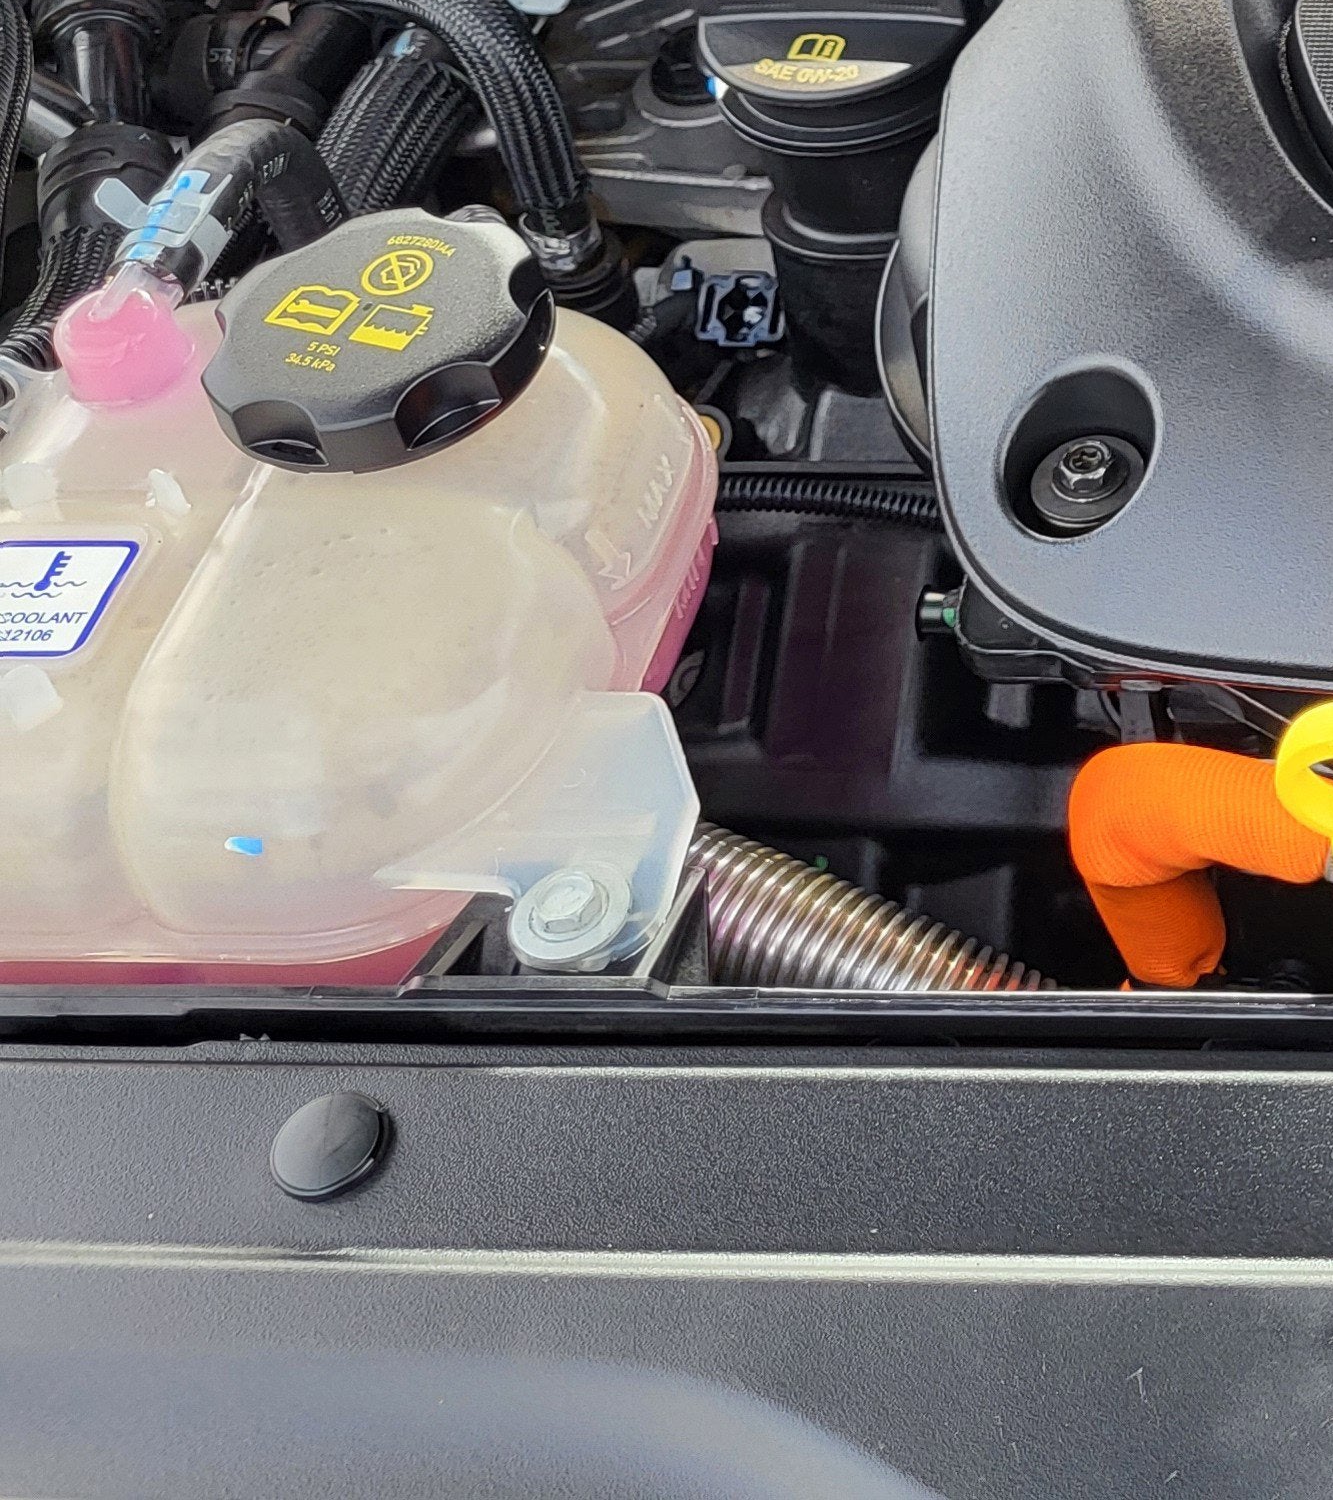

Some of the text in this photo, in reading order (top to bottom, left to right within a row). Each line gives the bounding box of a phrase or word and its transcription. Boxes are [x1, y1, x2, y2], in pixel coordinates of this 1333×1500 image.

[754, 58, 798, 81] SAE
[307, 341, 341, 357] 5 PSI
[310, 358, 336, 372] kPa
